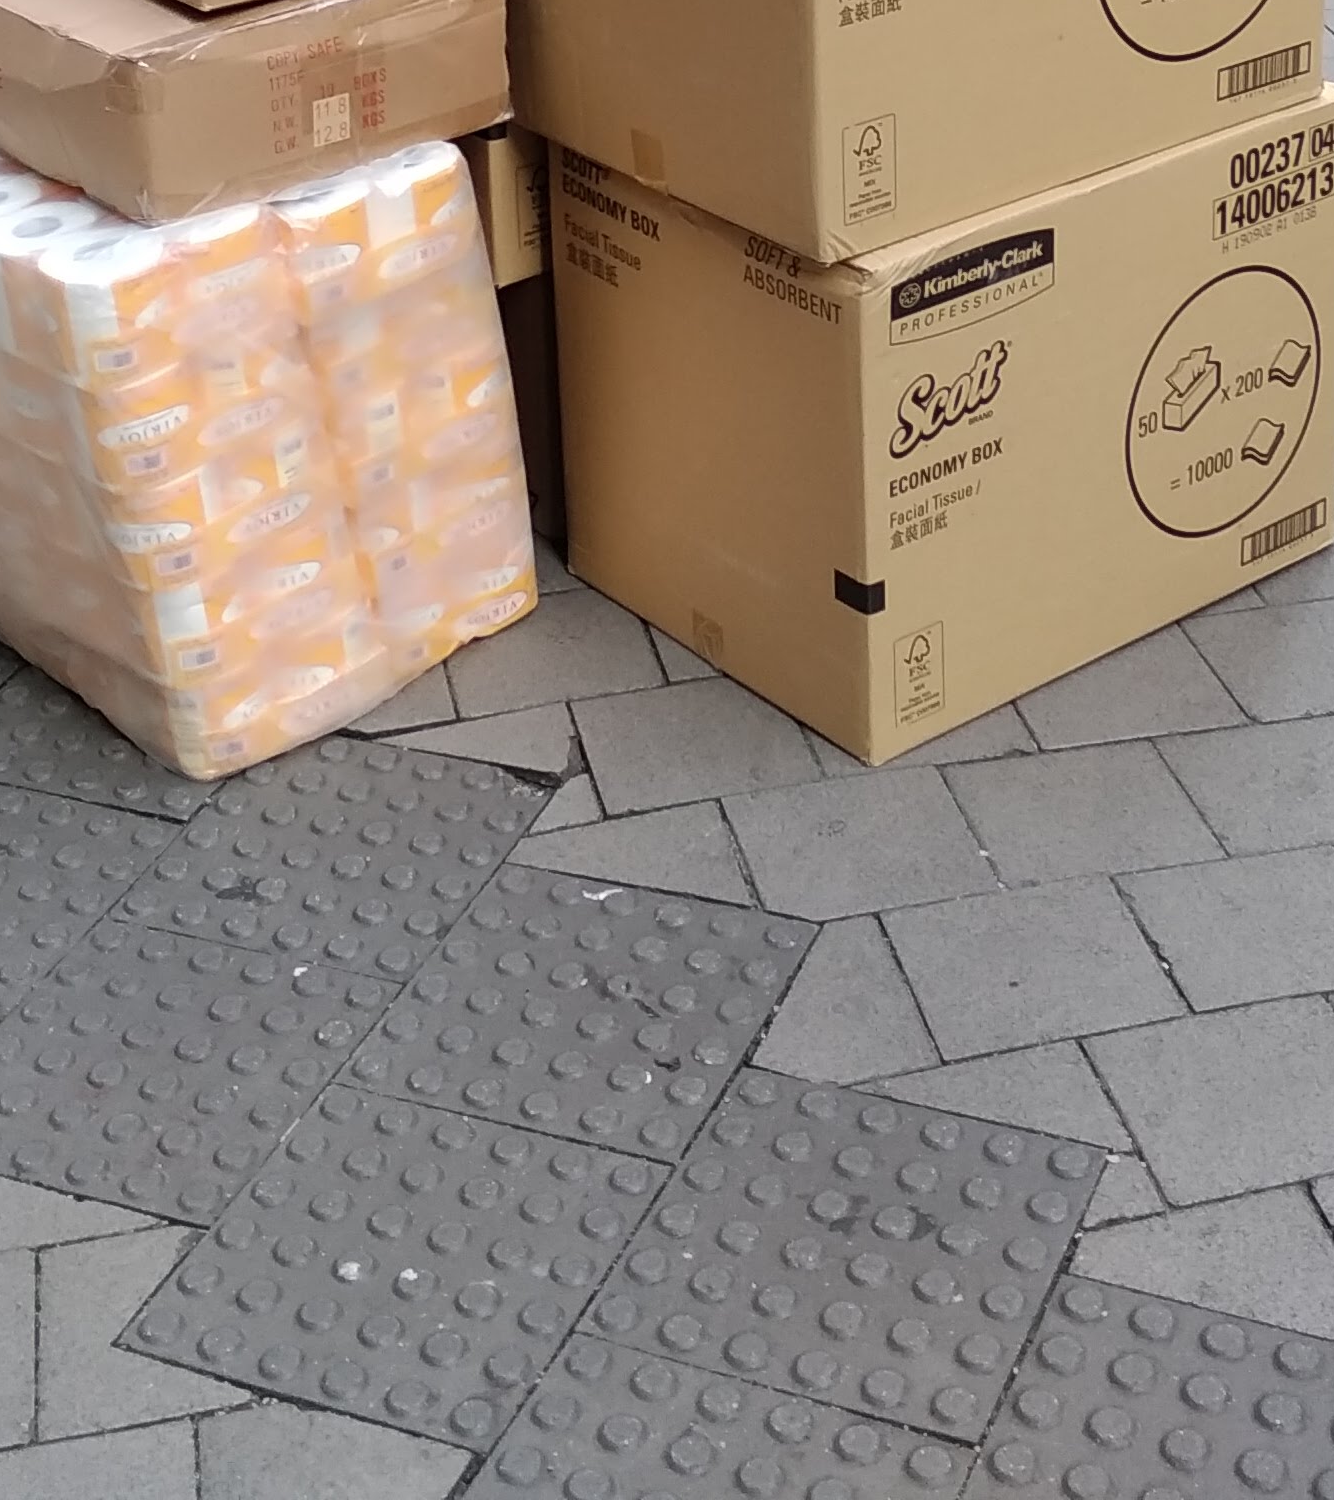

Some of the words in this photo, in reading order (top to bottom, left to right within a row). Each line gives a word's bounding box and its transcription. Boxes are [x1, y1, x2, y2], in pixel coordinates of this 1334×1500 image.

[307, 36, 343, 60] SAFE
[1230, 130, 1306, 189] 00237
[562, 176, 627, 224] ECONOMY
[630, 209, 661, 242] BOX
[1217, 161, 1334, 236] 14006213
[564, 213, 600, 250] Facial
[602, 233, 642, 271] Tissue
[744, 234, 786, 271] SOFT
[786, 255, 803, 280] &
[923, 240, 1044, 299] Kimberly-Clark
[743, 264, 843, 325] ABSORBENT
[899, 274, 1040, 336] PROFESSIONAL
[889, 339, 1009, 460] Scott
[968, 409, 995, 426] BRAND
[1138, 411, 1158, 438] 50
[1235, 366, 1264, 399] 200
[889, 451, 969, 499] ECONOMY
[971, 436, 1004, 466] BOX
[1186, 447, 1234, 486] 10000
[889, 498, 929, 529] Facial
[932, 482, 974, 512] Tissue
